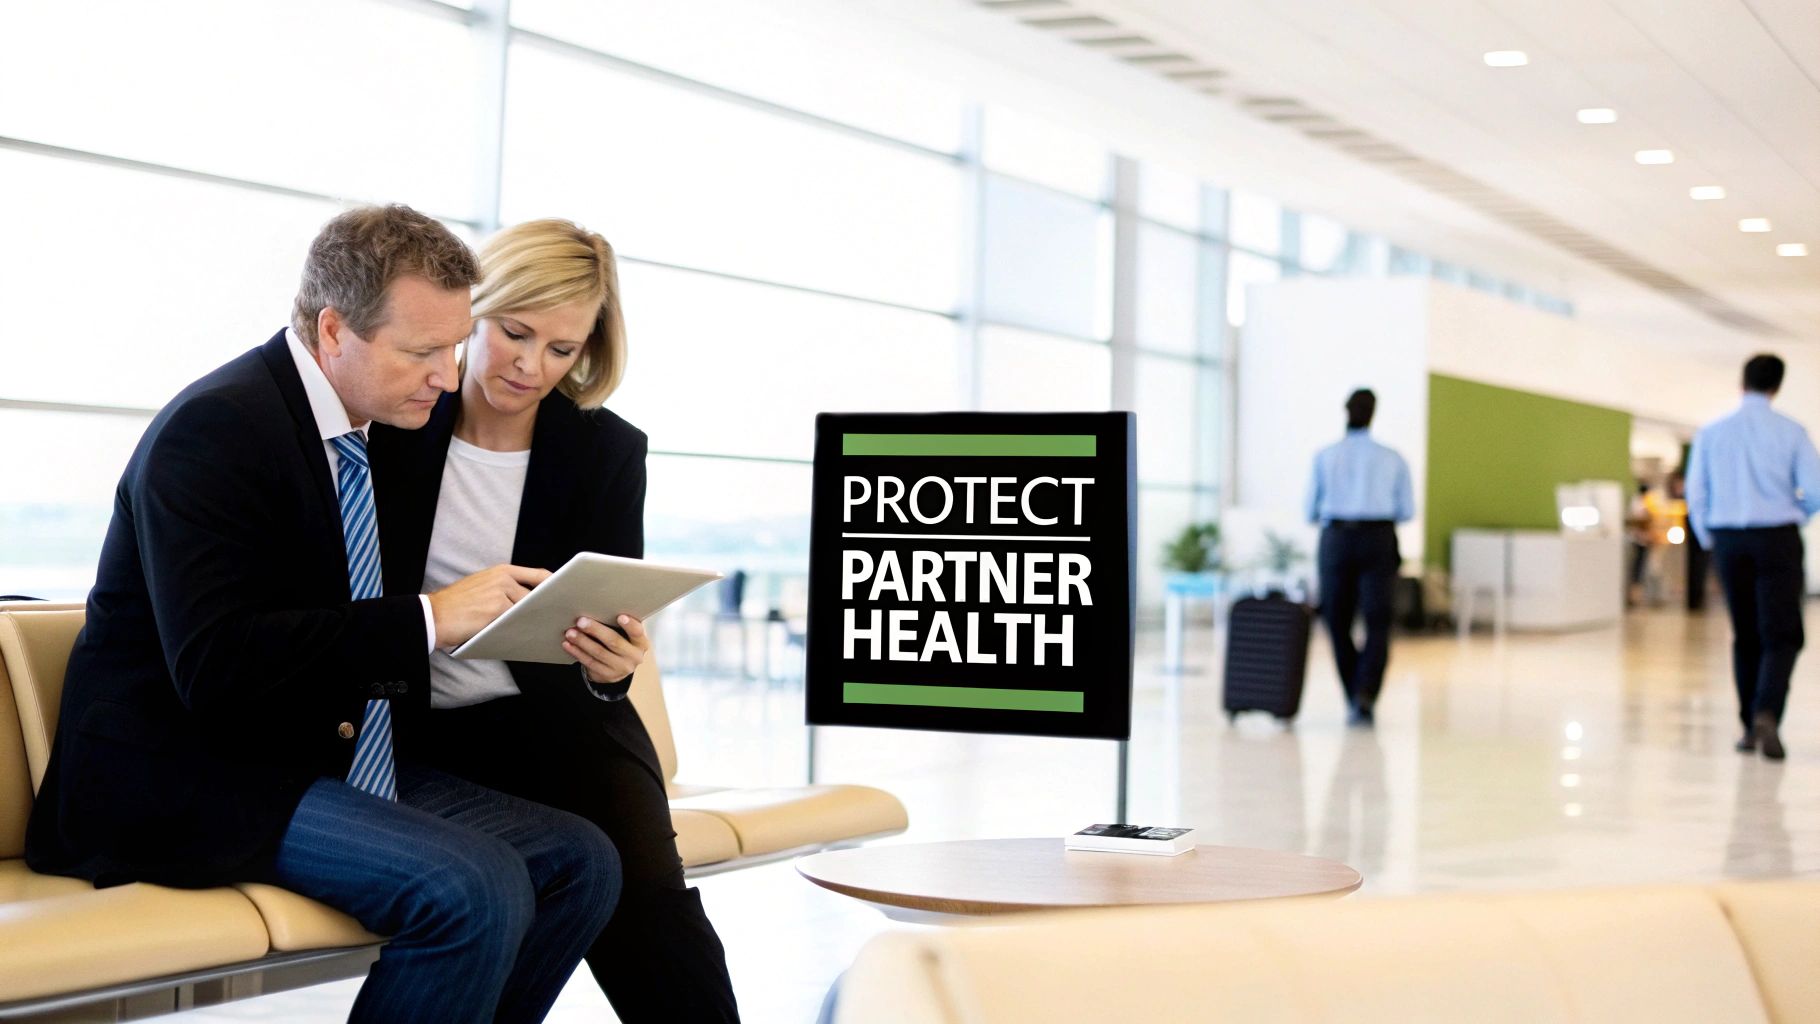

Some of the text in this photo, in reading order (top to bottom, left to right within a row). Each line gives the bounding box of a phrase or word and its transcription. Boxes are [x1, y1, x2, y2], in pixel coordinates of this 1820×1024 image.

[844, 476, 1095, 525] PROTECT
[842, 550, 1093, 605] PARTNER
[844, 609, 1073, 666] HEALTH
